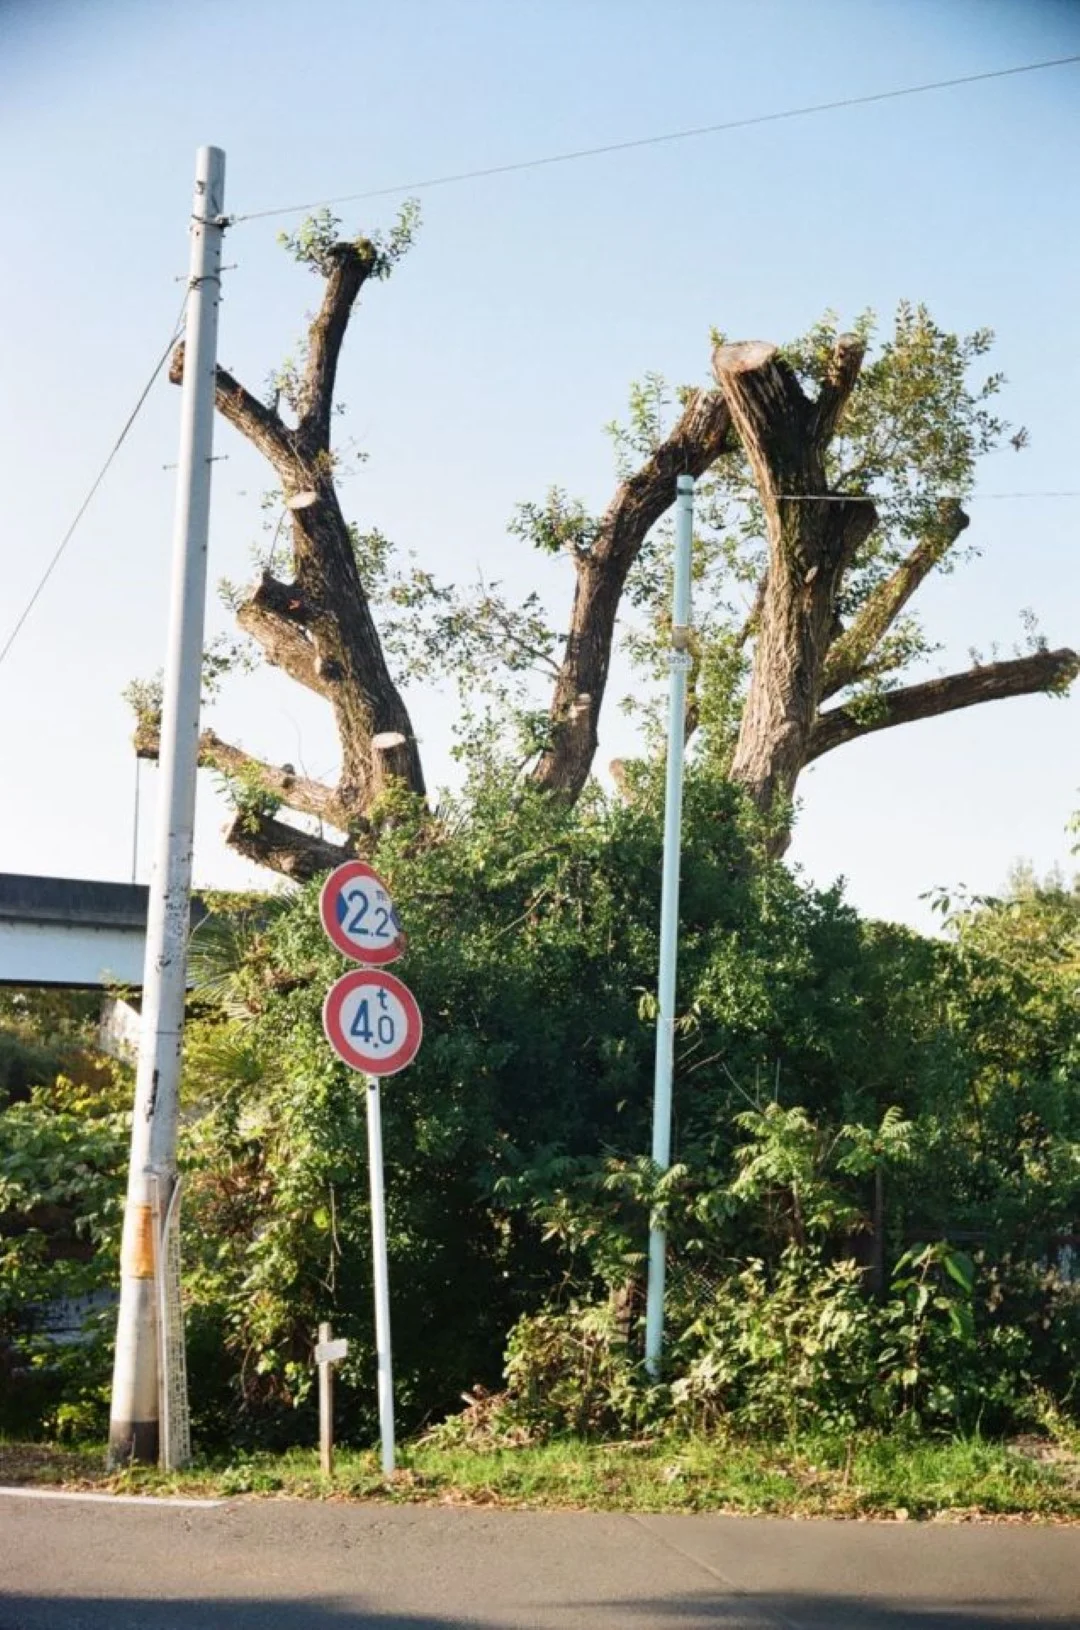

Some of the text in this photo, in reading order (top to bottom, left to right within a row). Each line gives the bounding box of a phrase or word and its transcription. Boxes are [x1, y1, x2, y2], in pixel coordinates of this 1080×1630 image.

[347, 890, 390, 938] 2.2
[376, 988, 388, 1010] t
[350, 999, 395, 1048] 4.0
